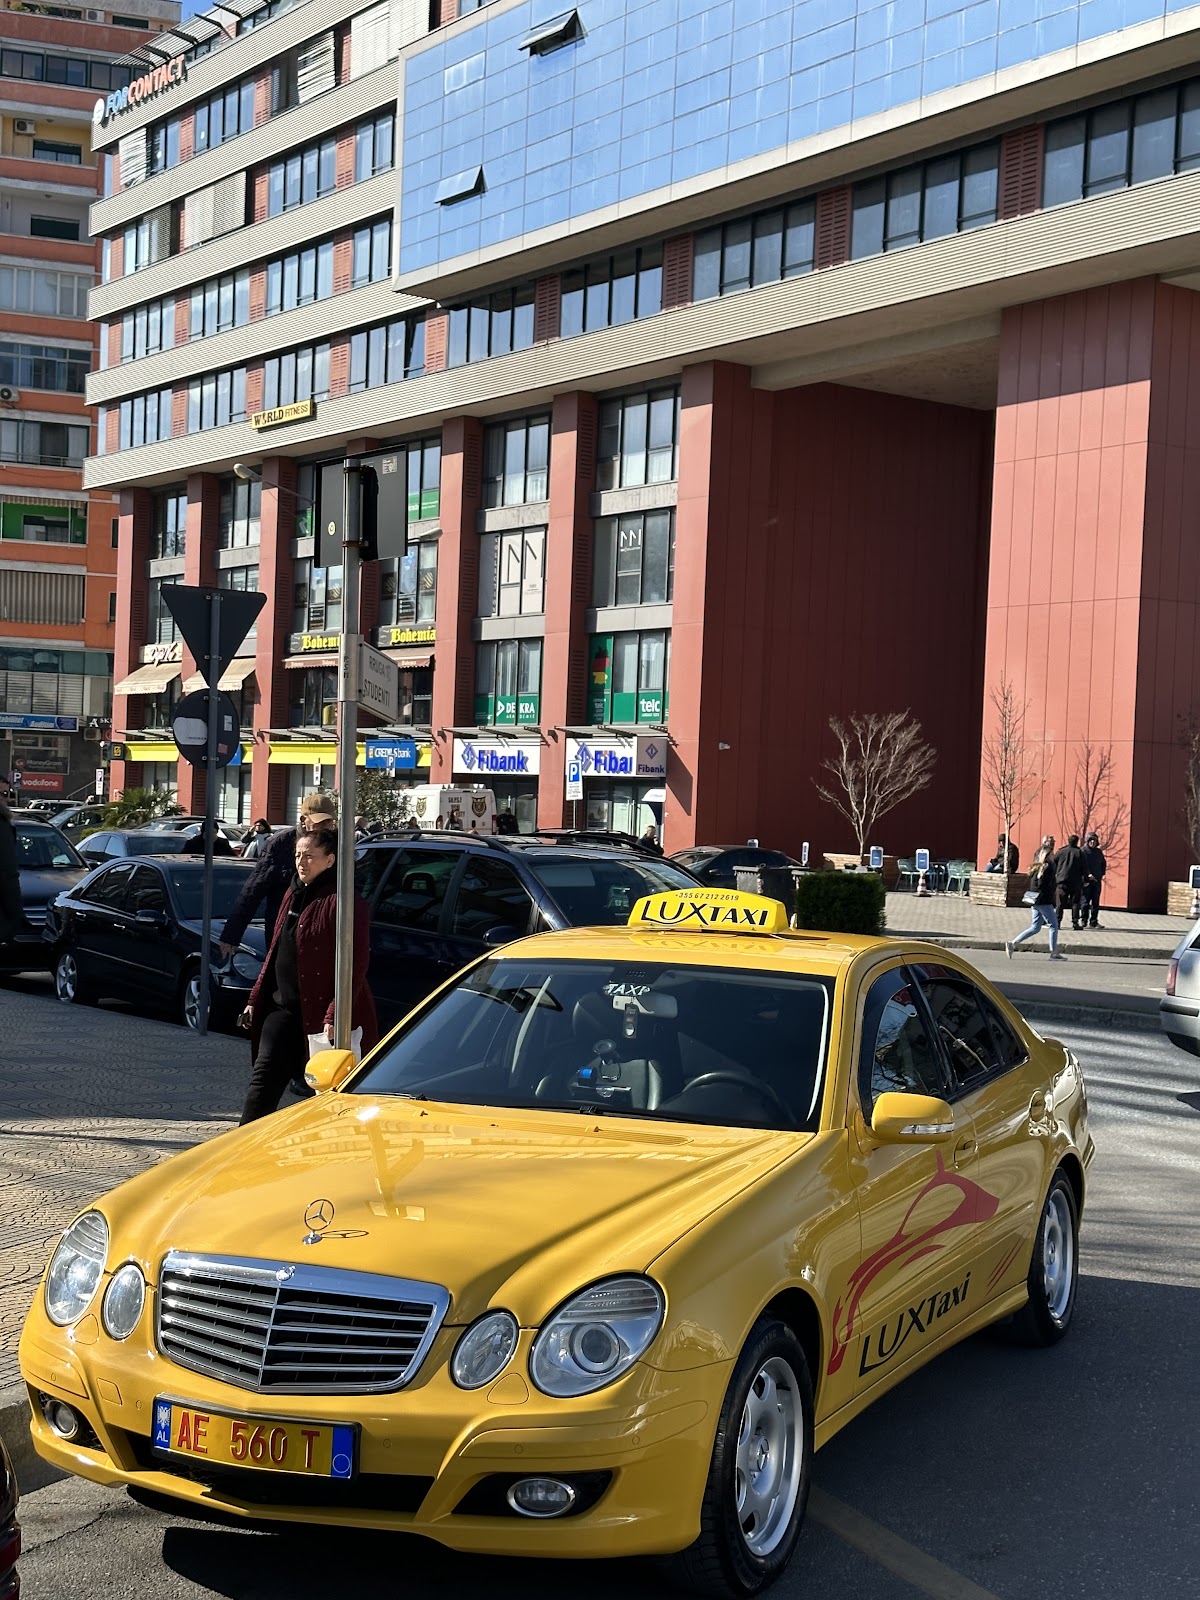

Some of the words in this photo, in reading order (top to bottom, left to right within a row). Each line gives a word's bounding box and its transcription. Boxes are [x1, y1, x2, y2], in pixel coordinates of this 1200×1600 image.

[285, 404, 309, 418] FITNESS
[390, 626, 436, 645] Bohemia
[369, 655, 386, 677] RRUGA
[363, 678, 390, 706] STUDENTI
[640, 698, 660, 712] telc
[397, 747, 411, 758] bank
[478, 749, 528, 771] Fibank
[569, 762, 578, 781] P
[637, 763, 665, 773] Fibank
[13, 772, 22, 783] P
[22, 779, 59, 787] vodafone
[858, 1272, 972, 1377] LUXTaxi
[156, 1430, 169, 1443] AL
[177, 1409, 210, 1454] AE
[229, 1420, 289, 1465] 560
[301, 1429, 321, 1469] T
